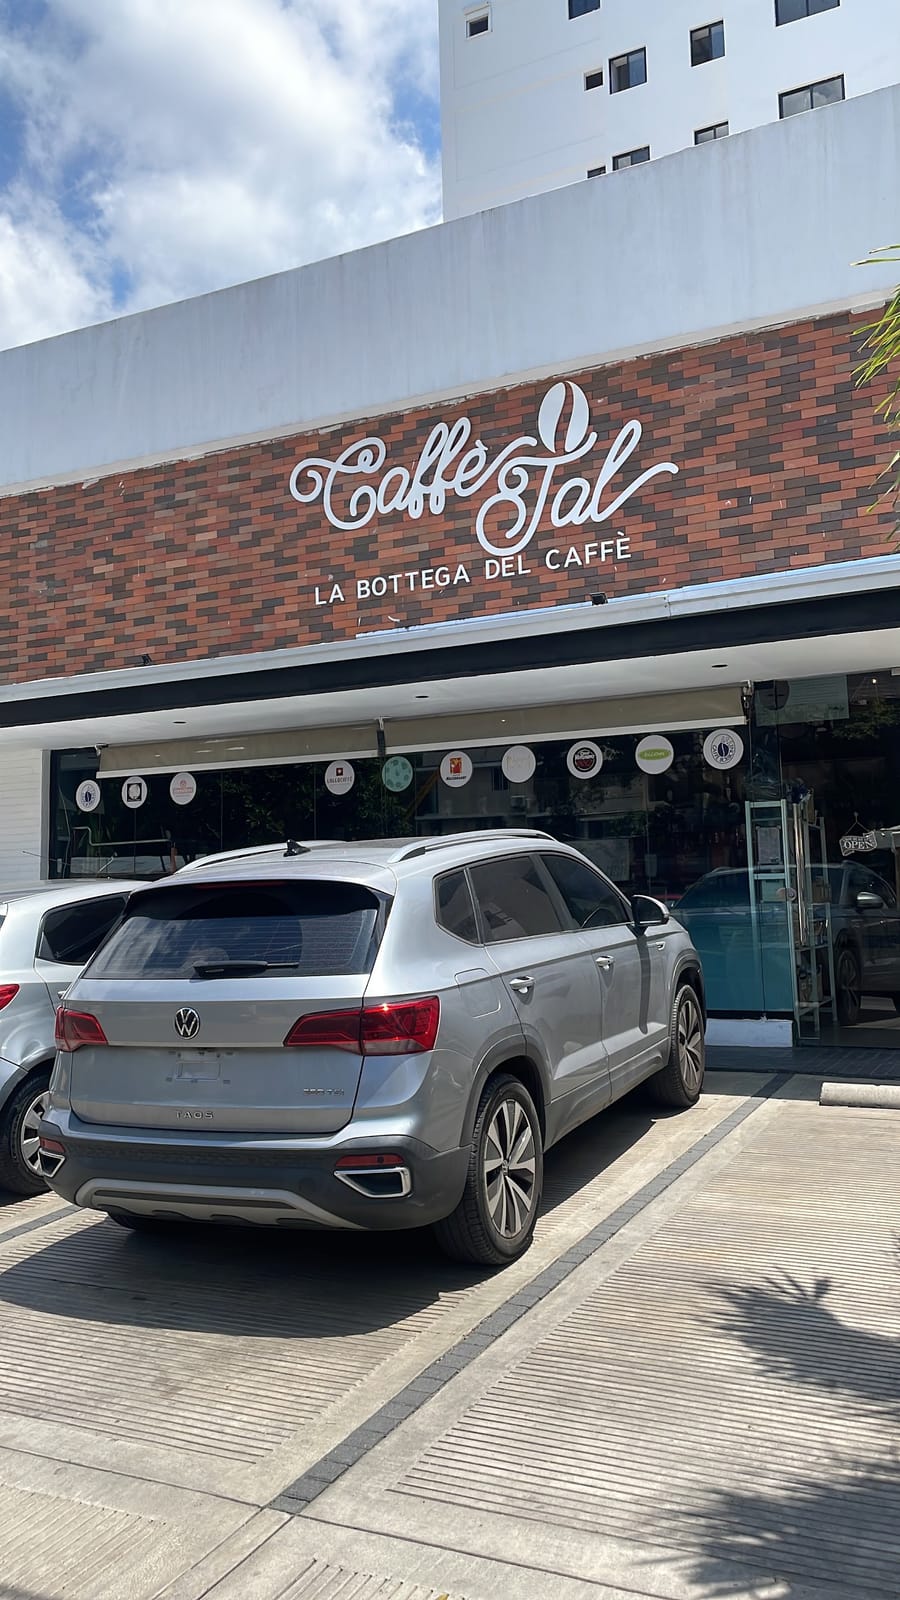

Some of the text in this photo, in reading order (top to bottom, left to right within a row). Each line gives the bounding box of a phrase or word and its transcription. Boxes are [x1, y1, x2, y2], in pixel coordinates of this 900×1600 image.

[289, 416, 538, 531] Caffè
[314, 530, 632, 606] LA BOTTEGA DEL CAFFÈ
[843, 840, 873, 850] OPEN
[175, 1111, 214, 1120] TAOS
